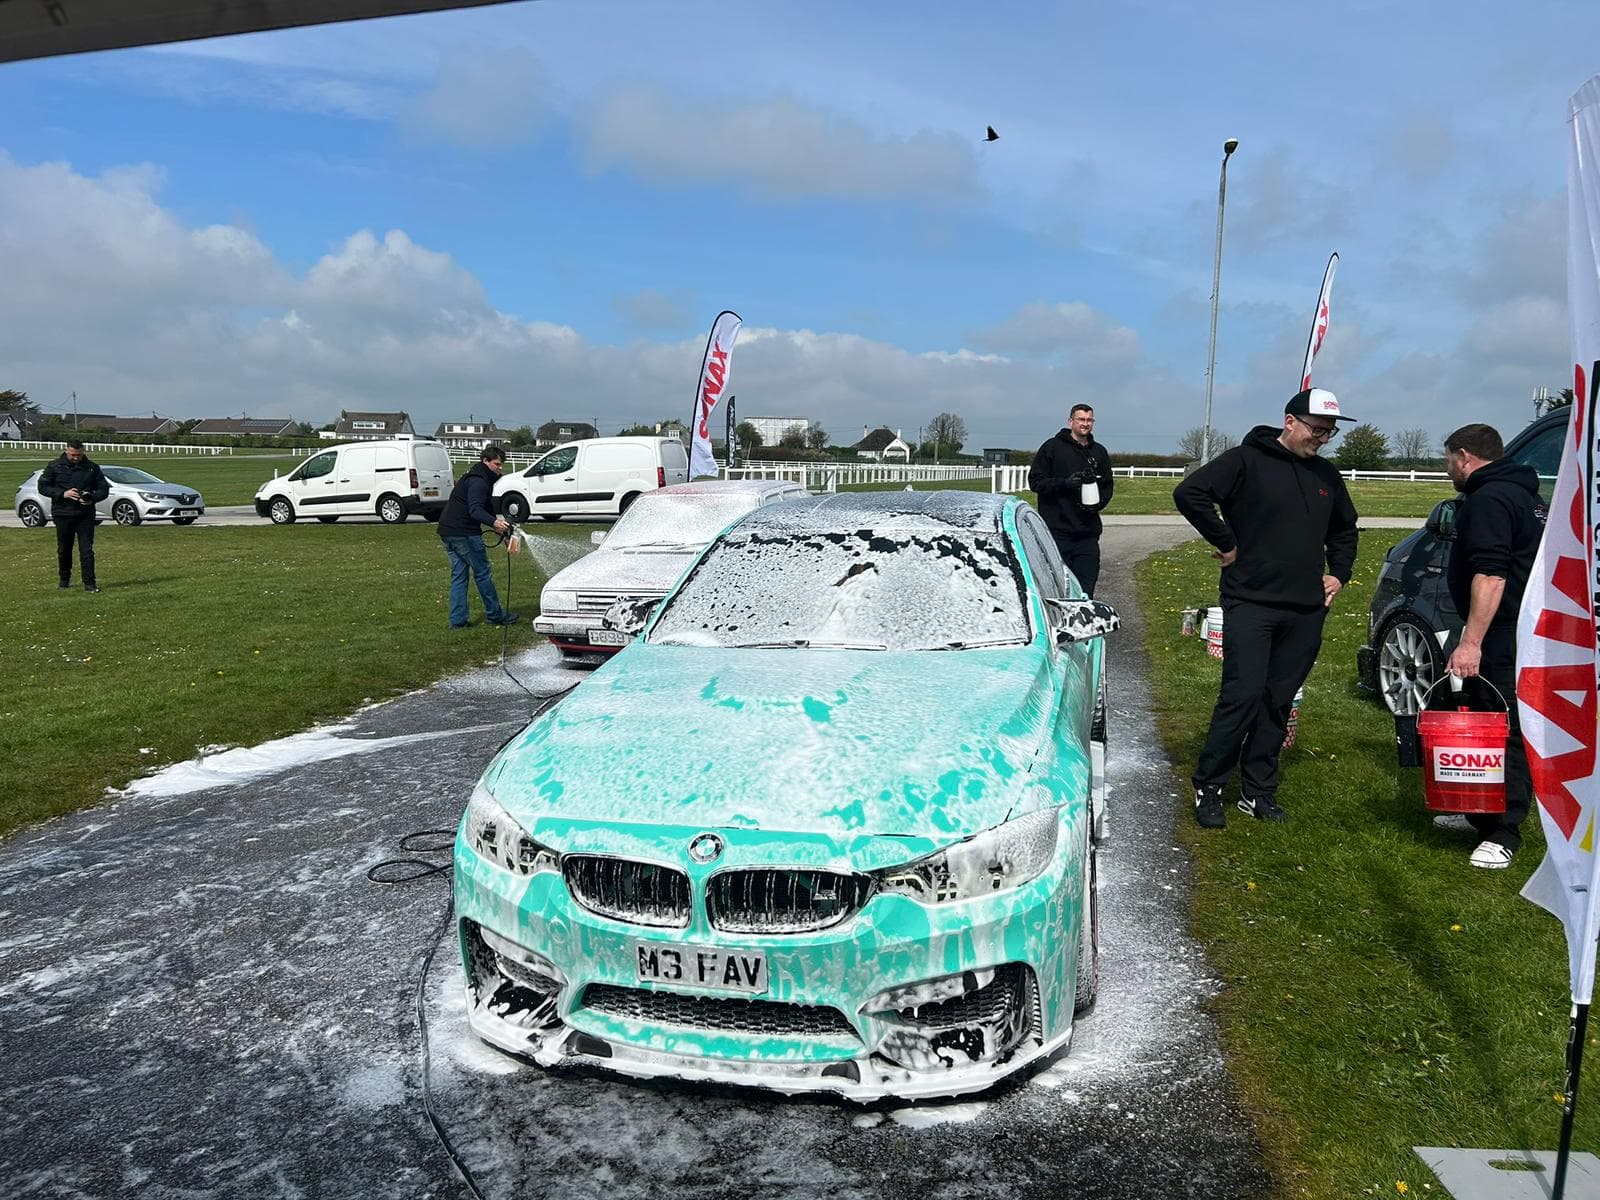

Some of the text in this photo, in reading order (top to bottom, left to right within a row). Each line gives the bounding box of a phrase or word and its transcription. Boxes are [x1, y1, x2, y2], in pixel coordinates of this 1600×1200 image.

[699, 340, 727, 440] SNAX
[1439, 753, 1503, 767] SONAX
[638, 946, 761, 986] M3 FAV
